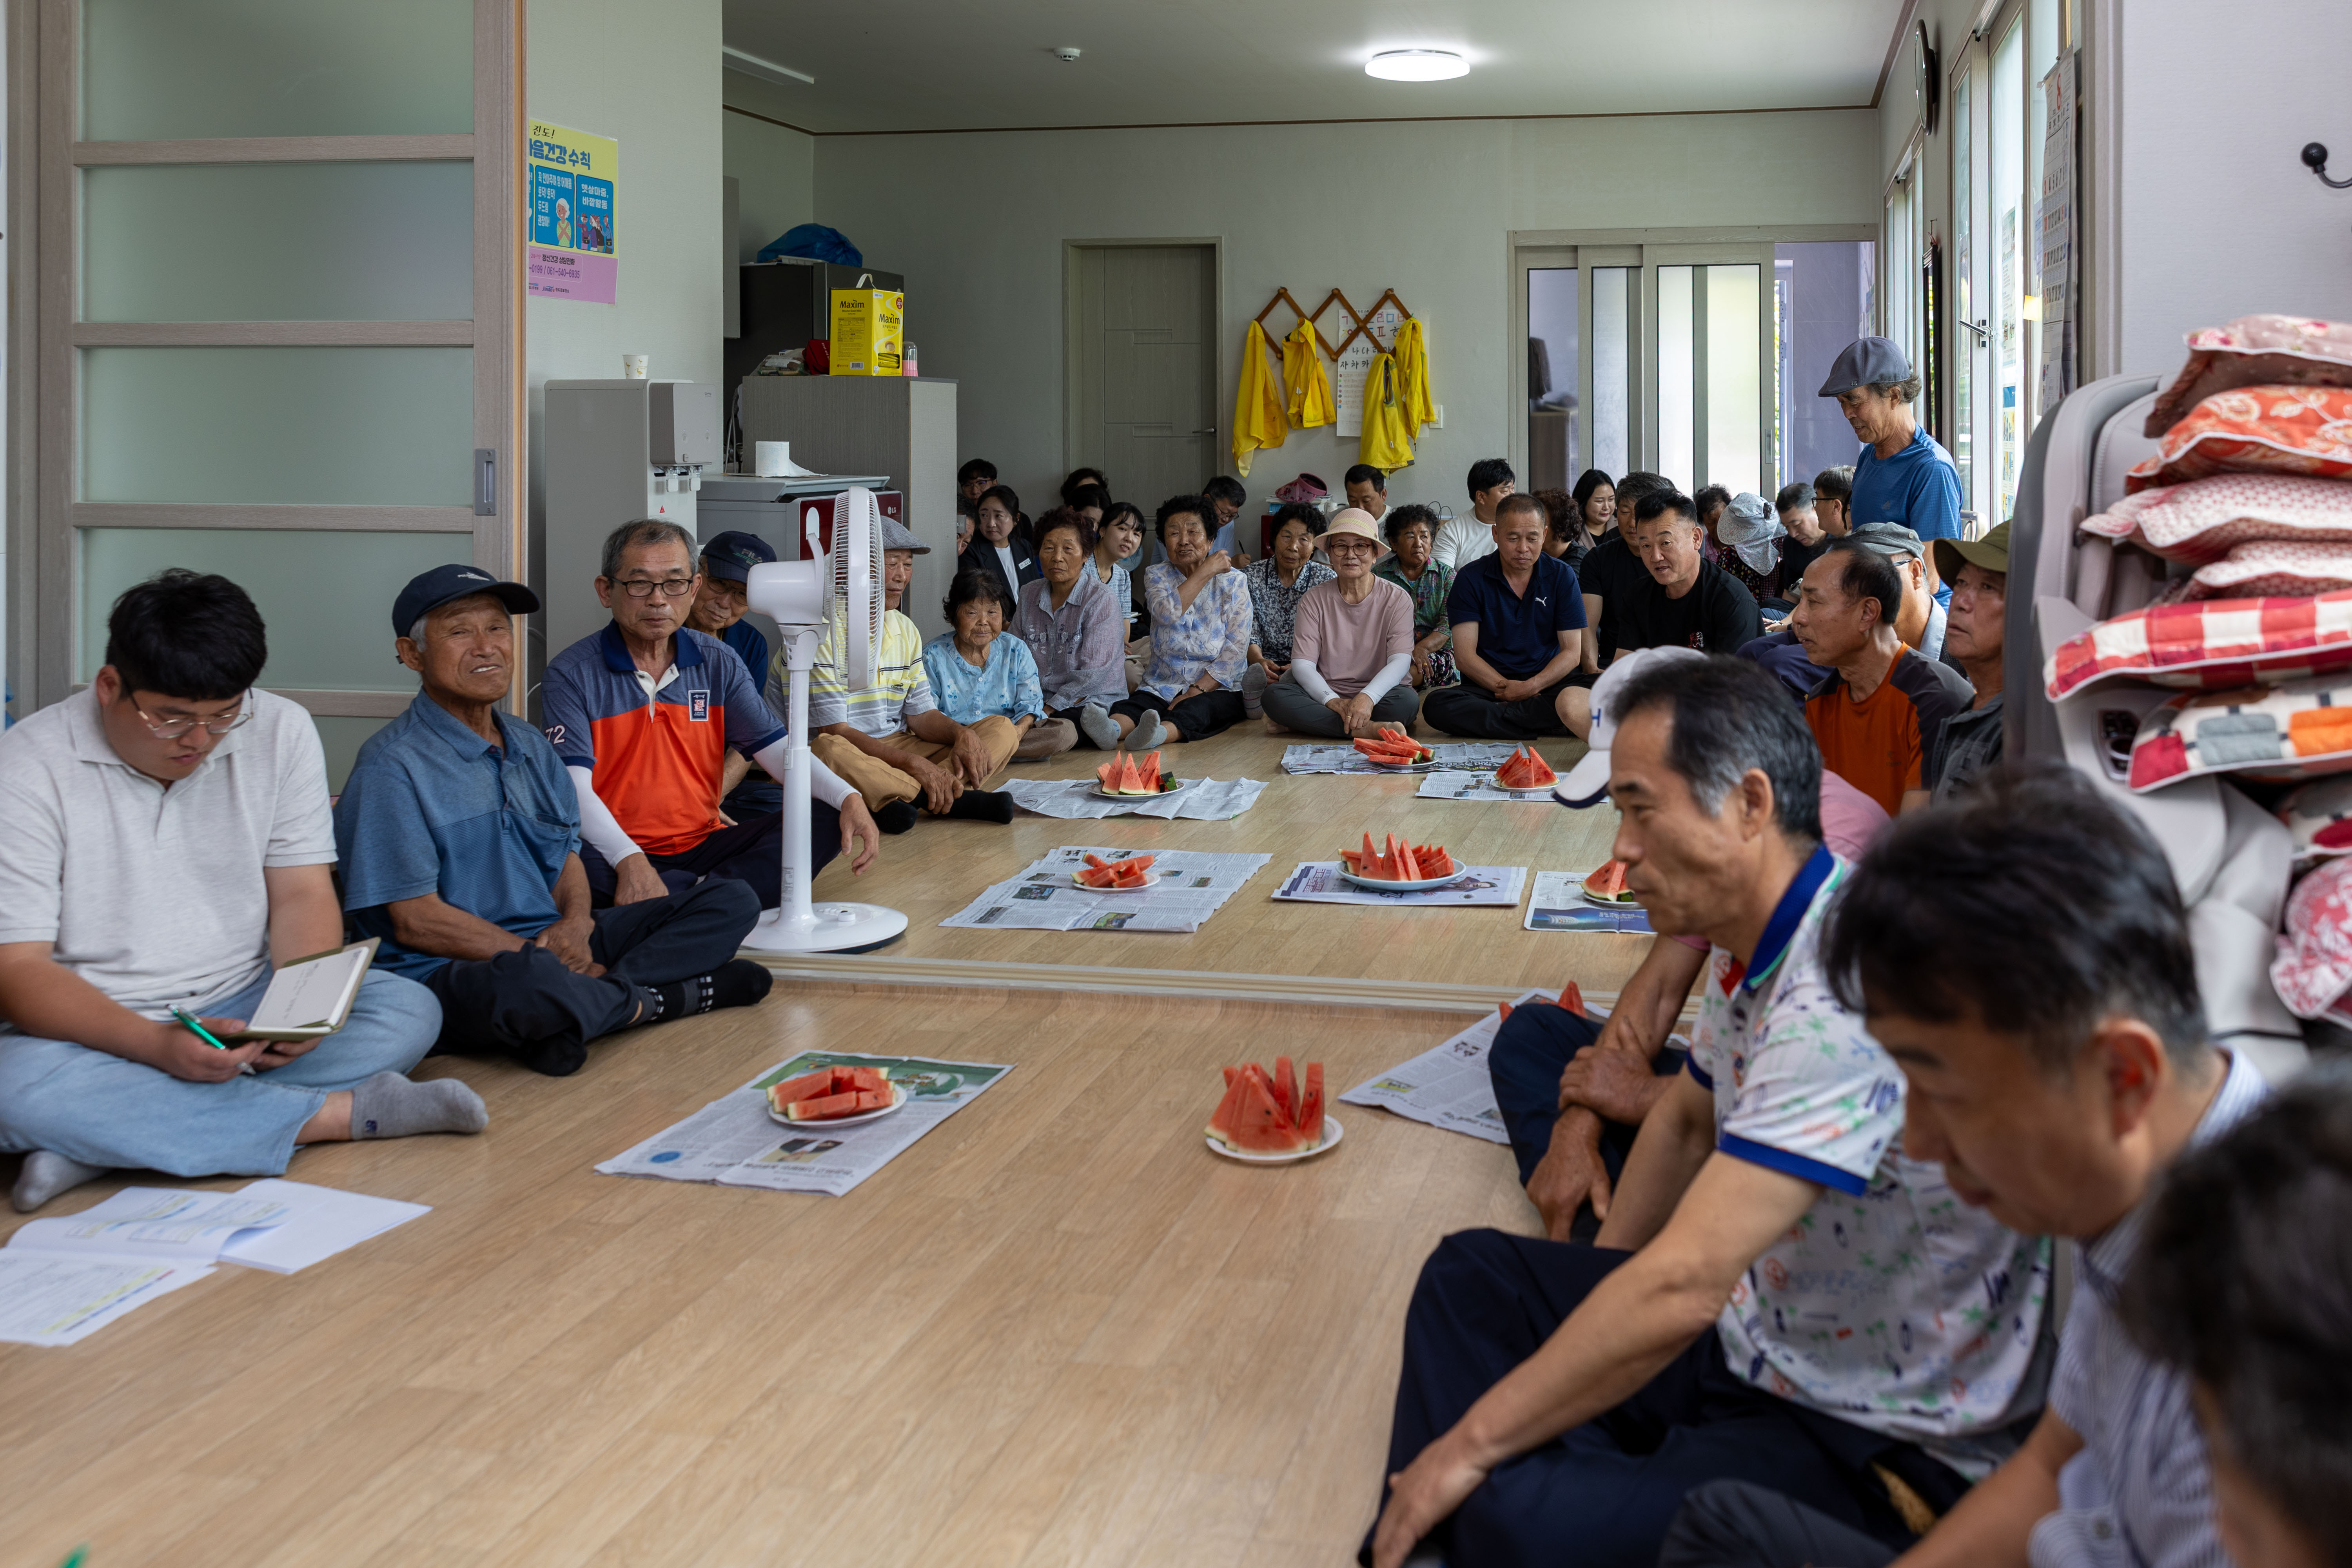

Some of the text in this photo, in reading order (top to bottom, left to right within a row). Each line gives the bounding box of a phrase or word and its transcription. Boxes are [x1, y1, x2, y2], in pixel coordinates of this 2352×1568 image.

[533, 125, 555, 139] 진도!
[568, 149, 590, 170] 수칙
[581, 184, 609, 198] 햇살마중,
[582, 196, 608, 209] 바깥활동
[542, 254, 558, 263] 정신건강
[559, 257, 575, 265] 상담전화
[547, 267, 580, 278] 061-540-6935
[840, 299, 864, 309] Maxim
[878, 314, 900, 324] Maxim
[741, 548, 763, 563] FILA
[545, 725, 565, 744] 72
